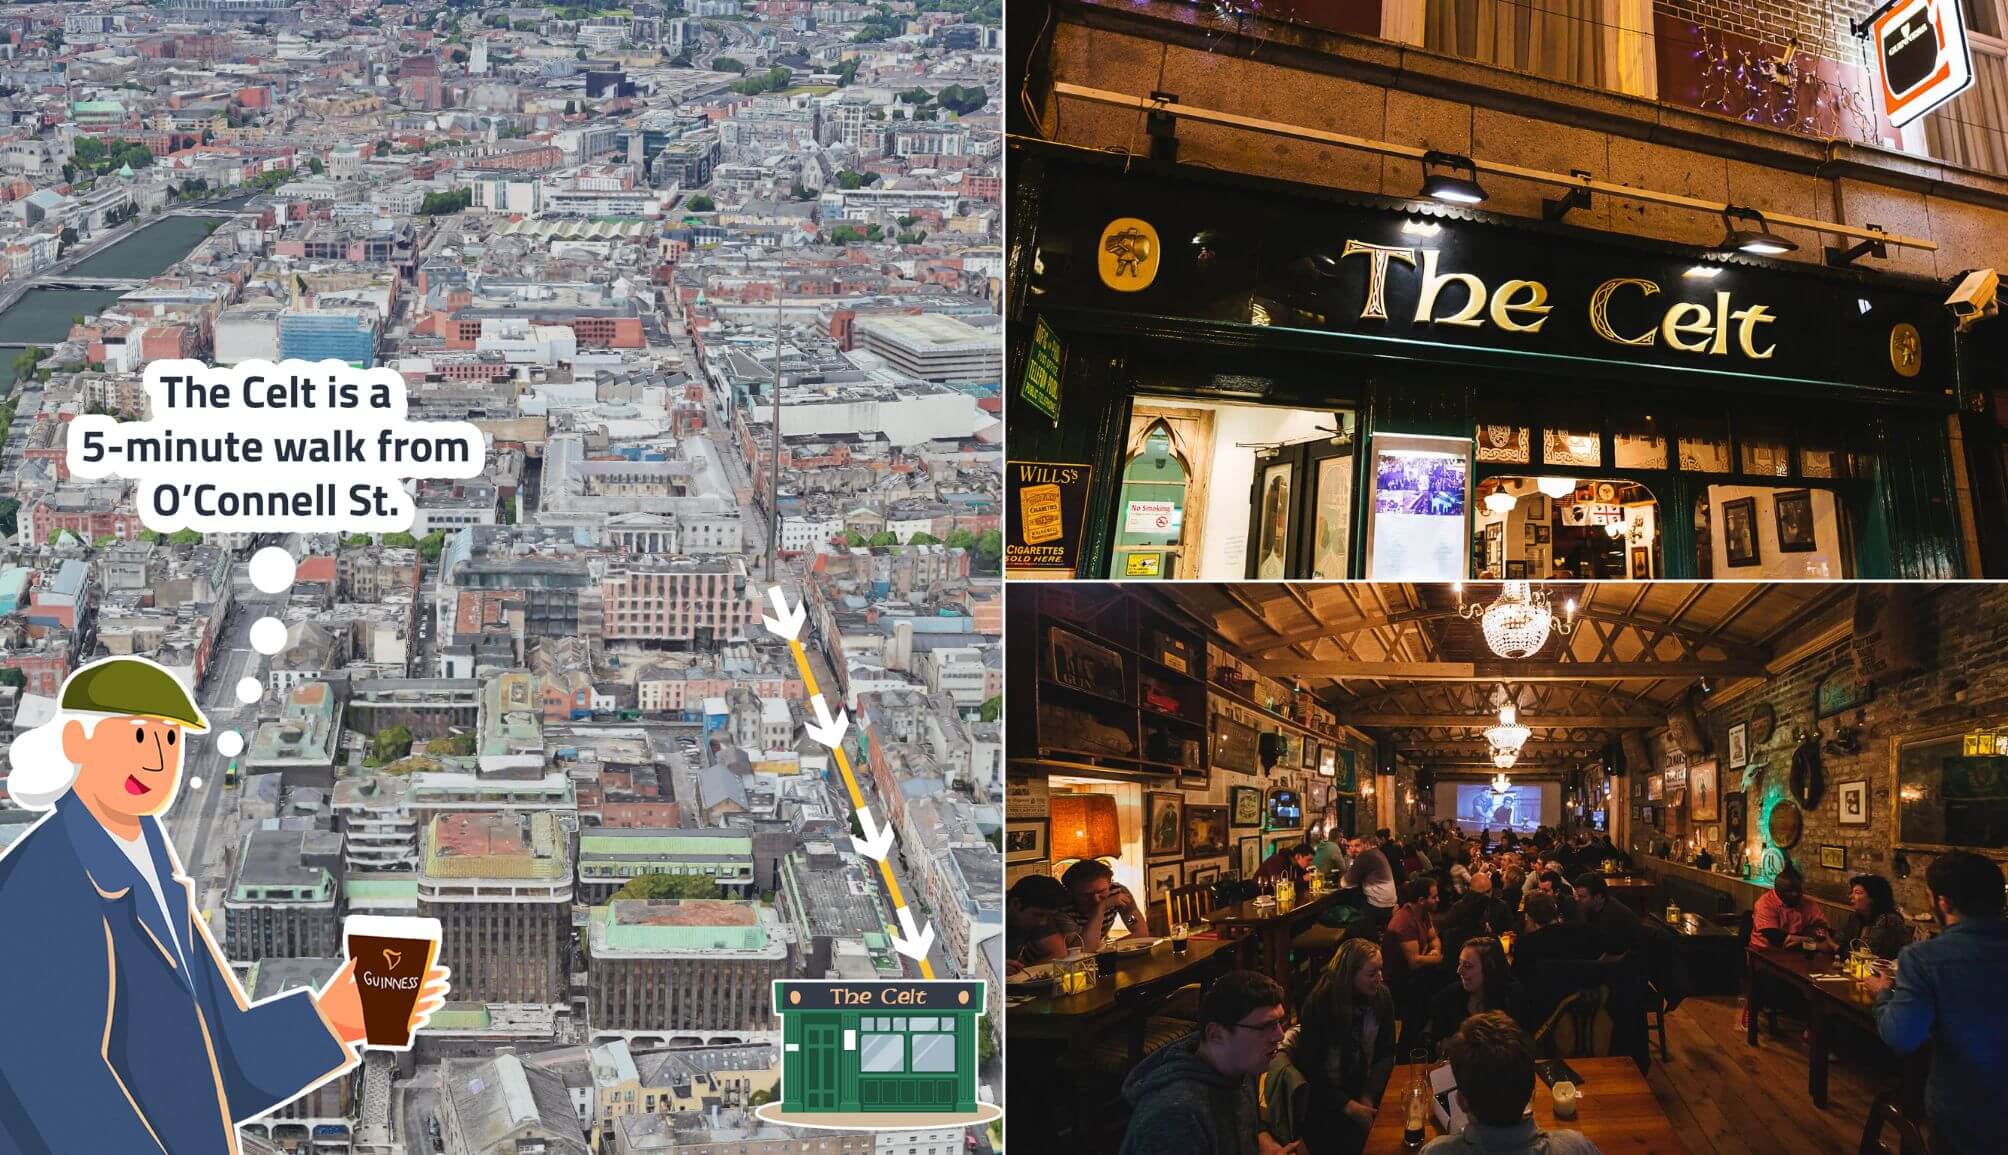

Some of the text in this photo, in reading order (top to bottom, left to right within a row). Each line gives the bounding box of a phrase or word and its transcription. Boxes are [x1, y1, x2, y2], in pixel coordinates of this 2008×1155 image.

[1341, 239, 1776, 359] The Celt
[1142, 504, 1171, 513] Smoking
[1006, 544, 1064, 555] CIGARETTES
